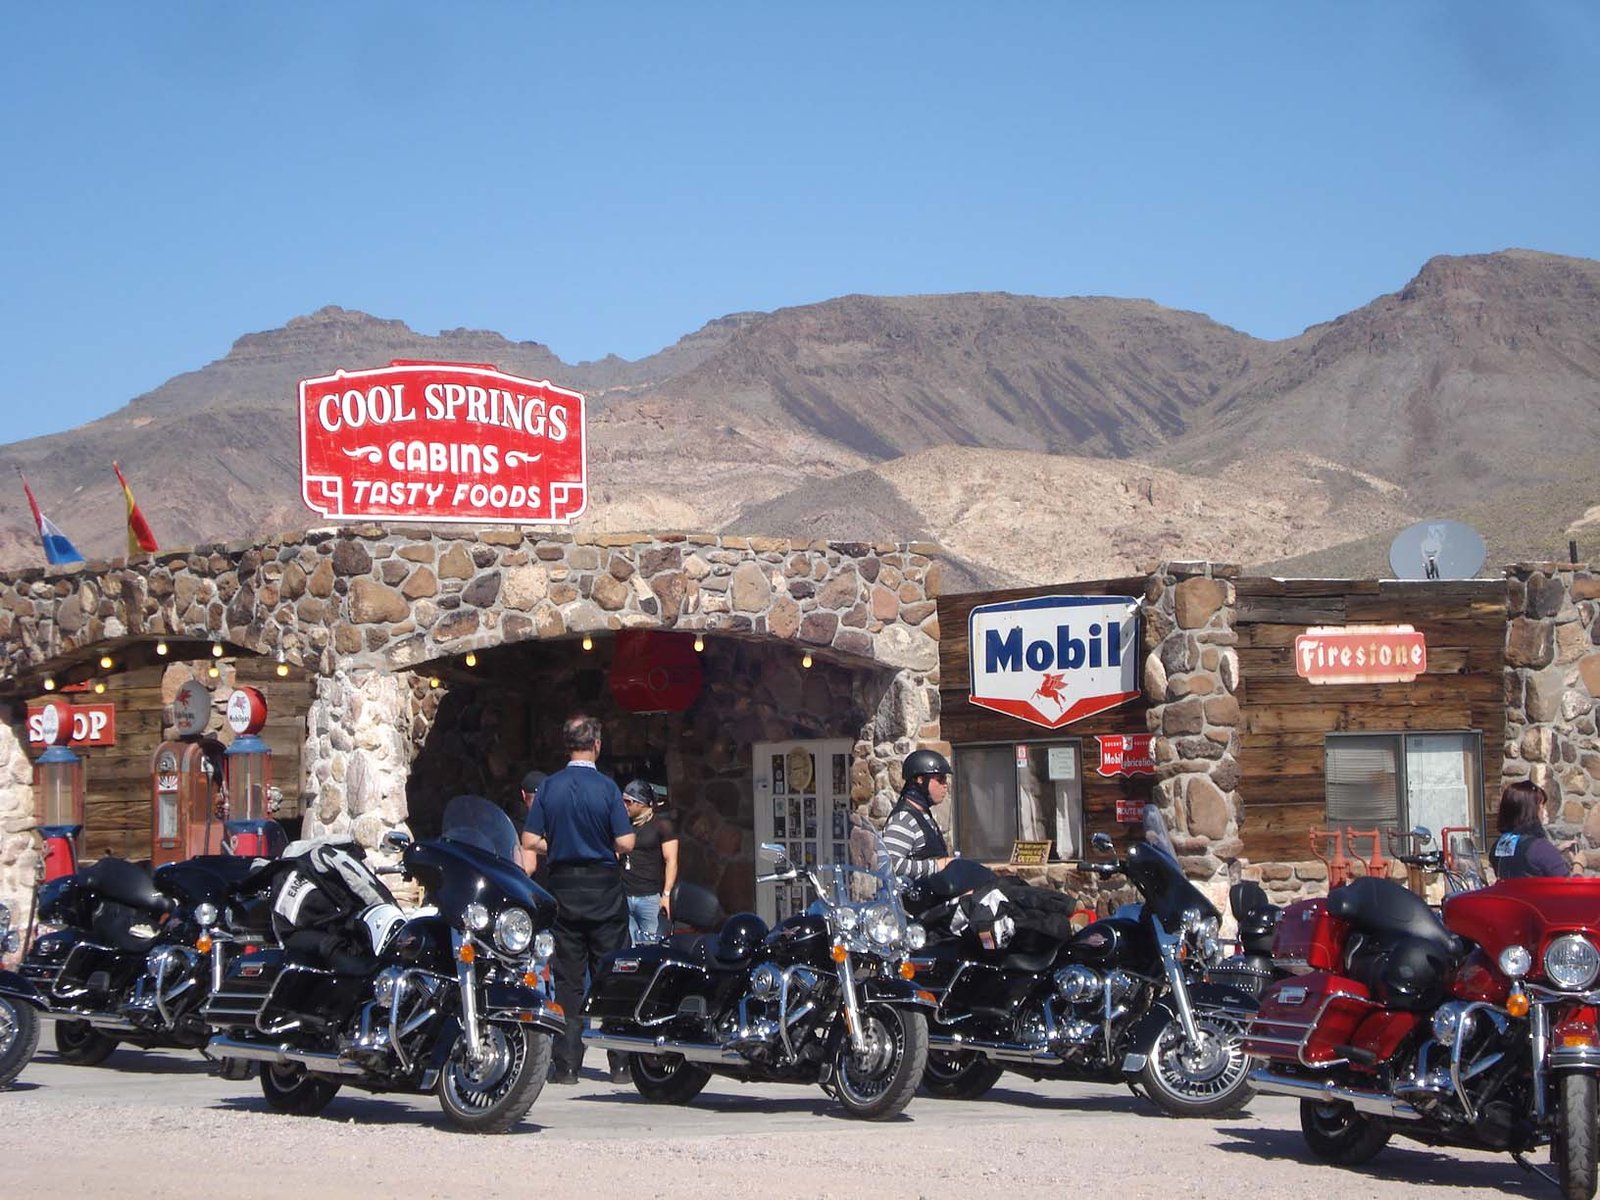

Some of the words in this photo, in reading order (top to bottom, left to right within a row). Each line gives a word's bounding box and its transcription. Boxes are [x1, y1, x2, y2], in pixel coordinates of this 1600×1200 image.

[319, 384, 416, 432] COOL
[425, 383, 568, 441] SPRINGS
[388, 440, 499, 474] CABINS
[352, 480, 444, 506] TASTY
[451, 483, 541, 509] FOODS
[985, 621, 1122, 674] Mobil
[1299, 639, 1424, 673] Firestone
[29, 711, 108, 742] SOP
